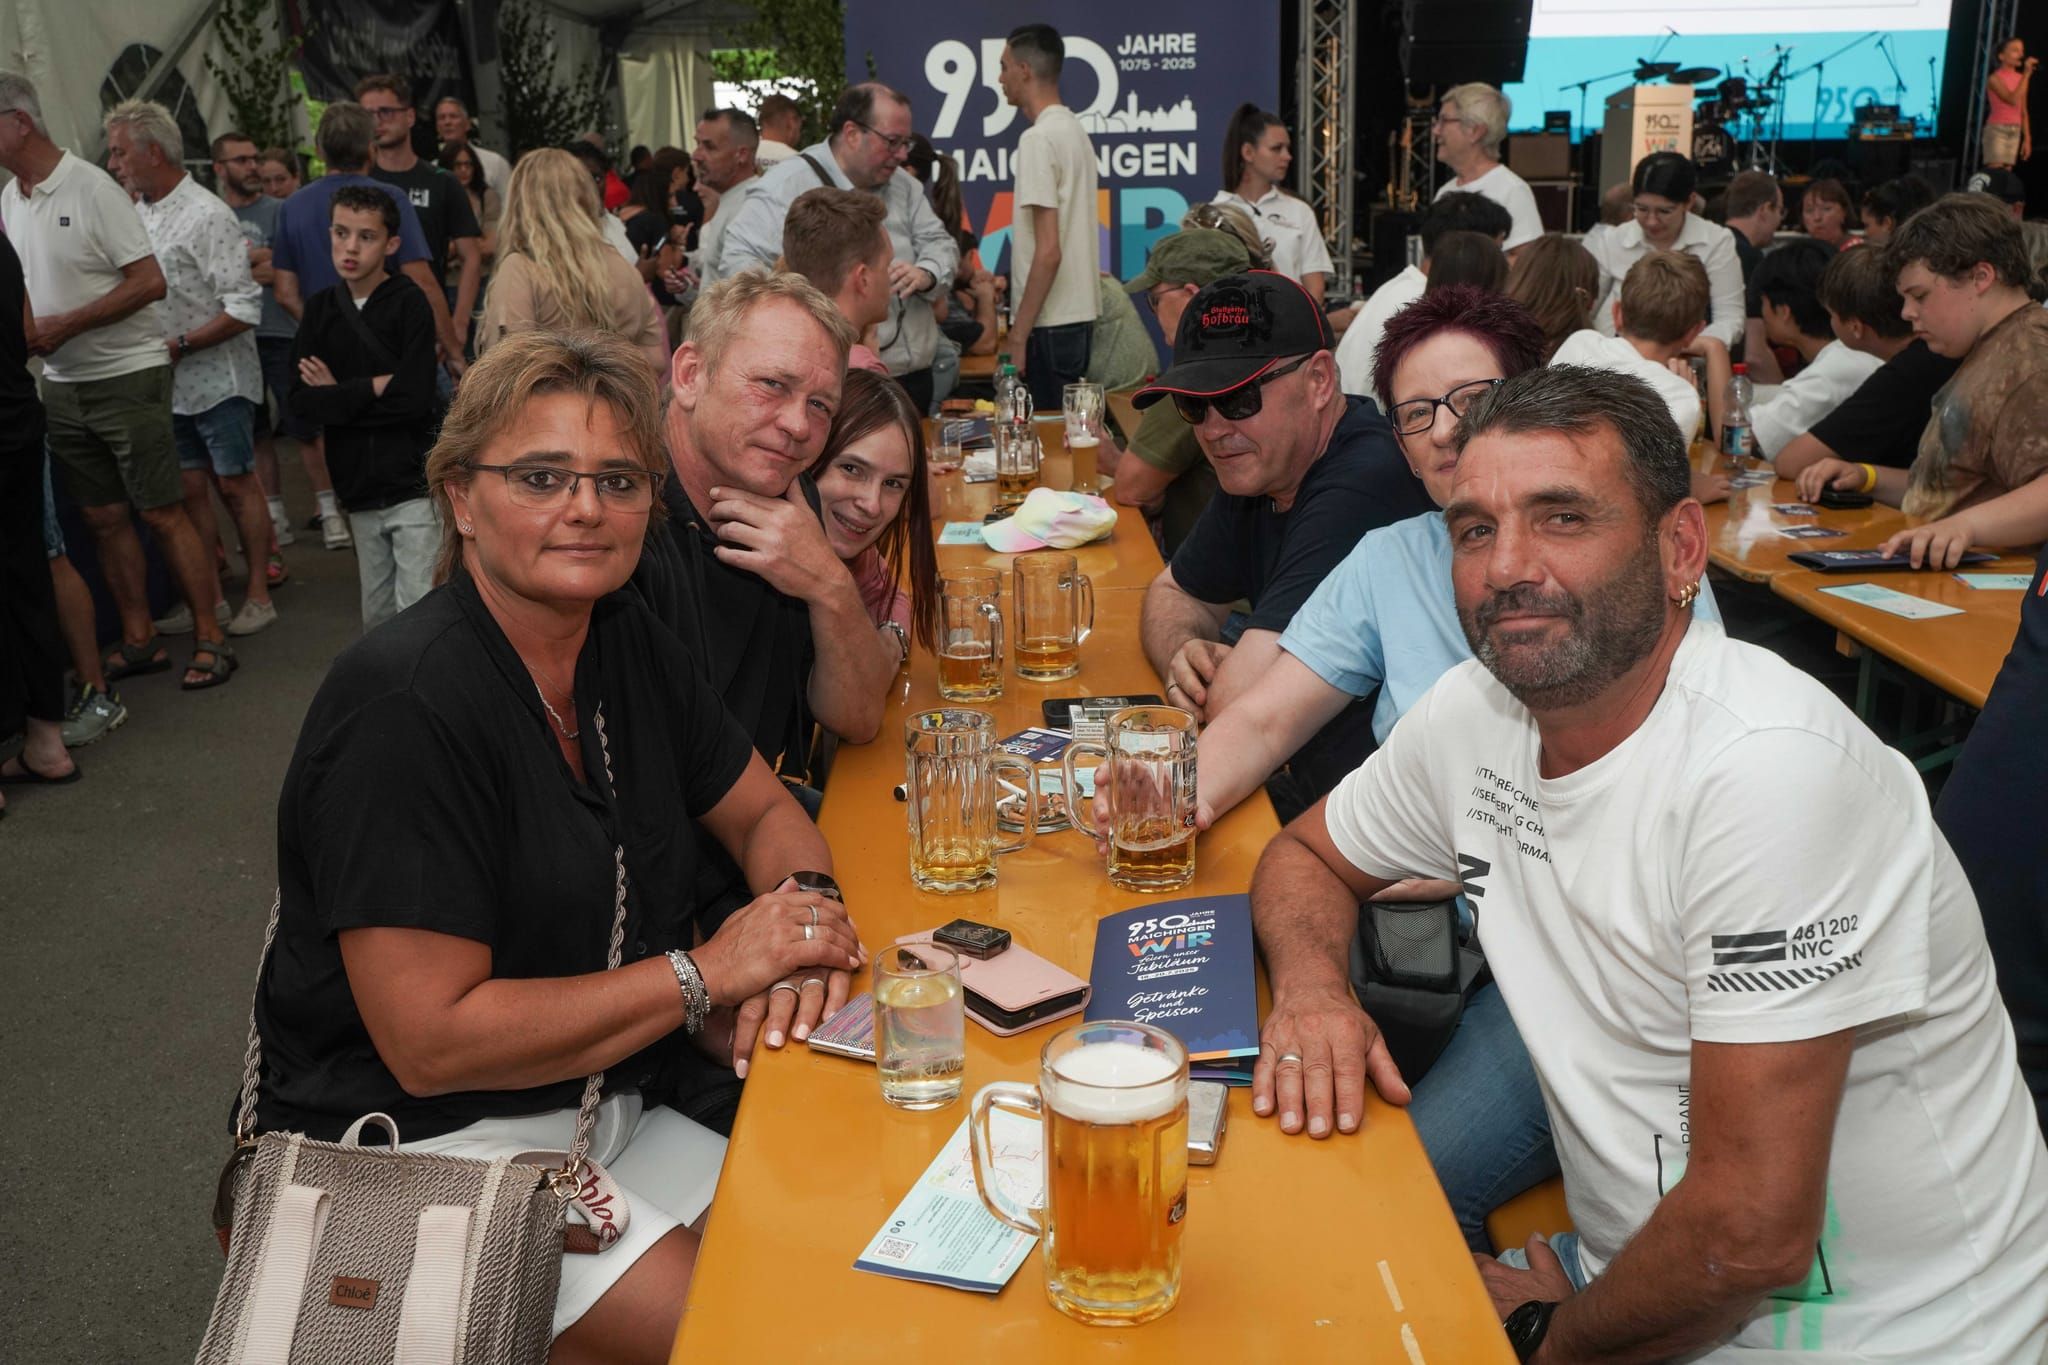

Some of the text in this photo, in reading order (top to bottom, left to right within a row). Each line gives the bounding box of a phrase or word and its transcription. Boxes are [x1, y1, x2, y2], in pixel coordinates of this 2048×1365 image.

[1117, 33, 1197, 55] JAHRE
[1119, 58, 1152, 71] 1075
[1161, 57, 1197, 70] 2025
[1127, 923, 1216, 944] MAICHINGEN
[1128, 914, 1190, 938] 950
[1793, 914, 1858, 941] 481202
[1127, 931, 1214, 957] WIR
[1791, 939, 1833, 961] NYC
[1126, 956, 1210, 975] Jubiläum
[1126, 985, 1210, 1008] Getränke
[1158, 998, 1184, 1008] und
[1134, 1007, 1203, 1023] Speisen
[336, 1284, 371, 1301] Chloé
